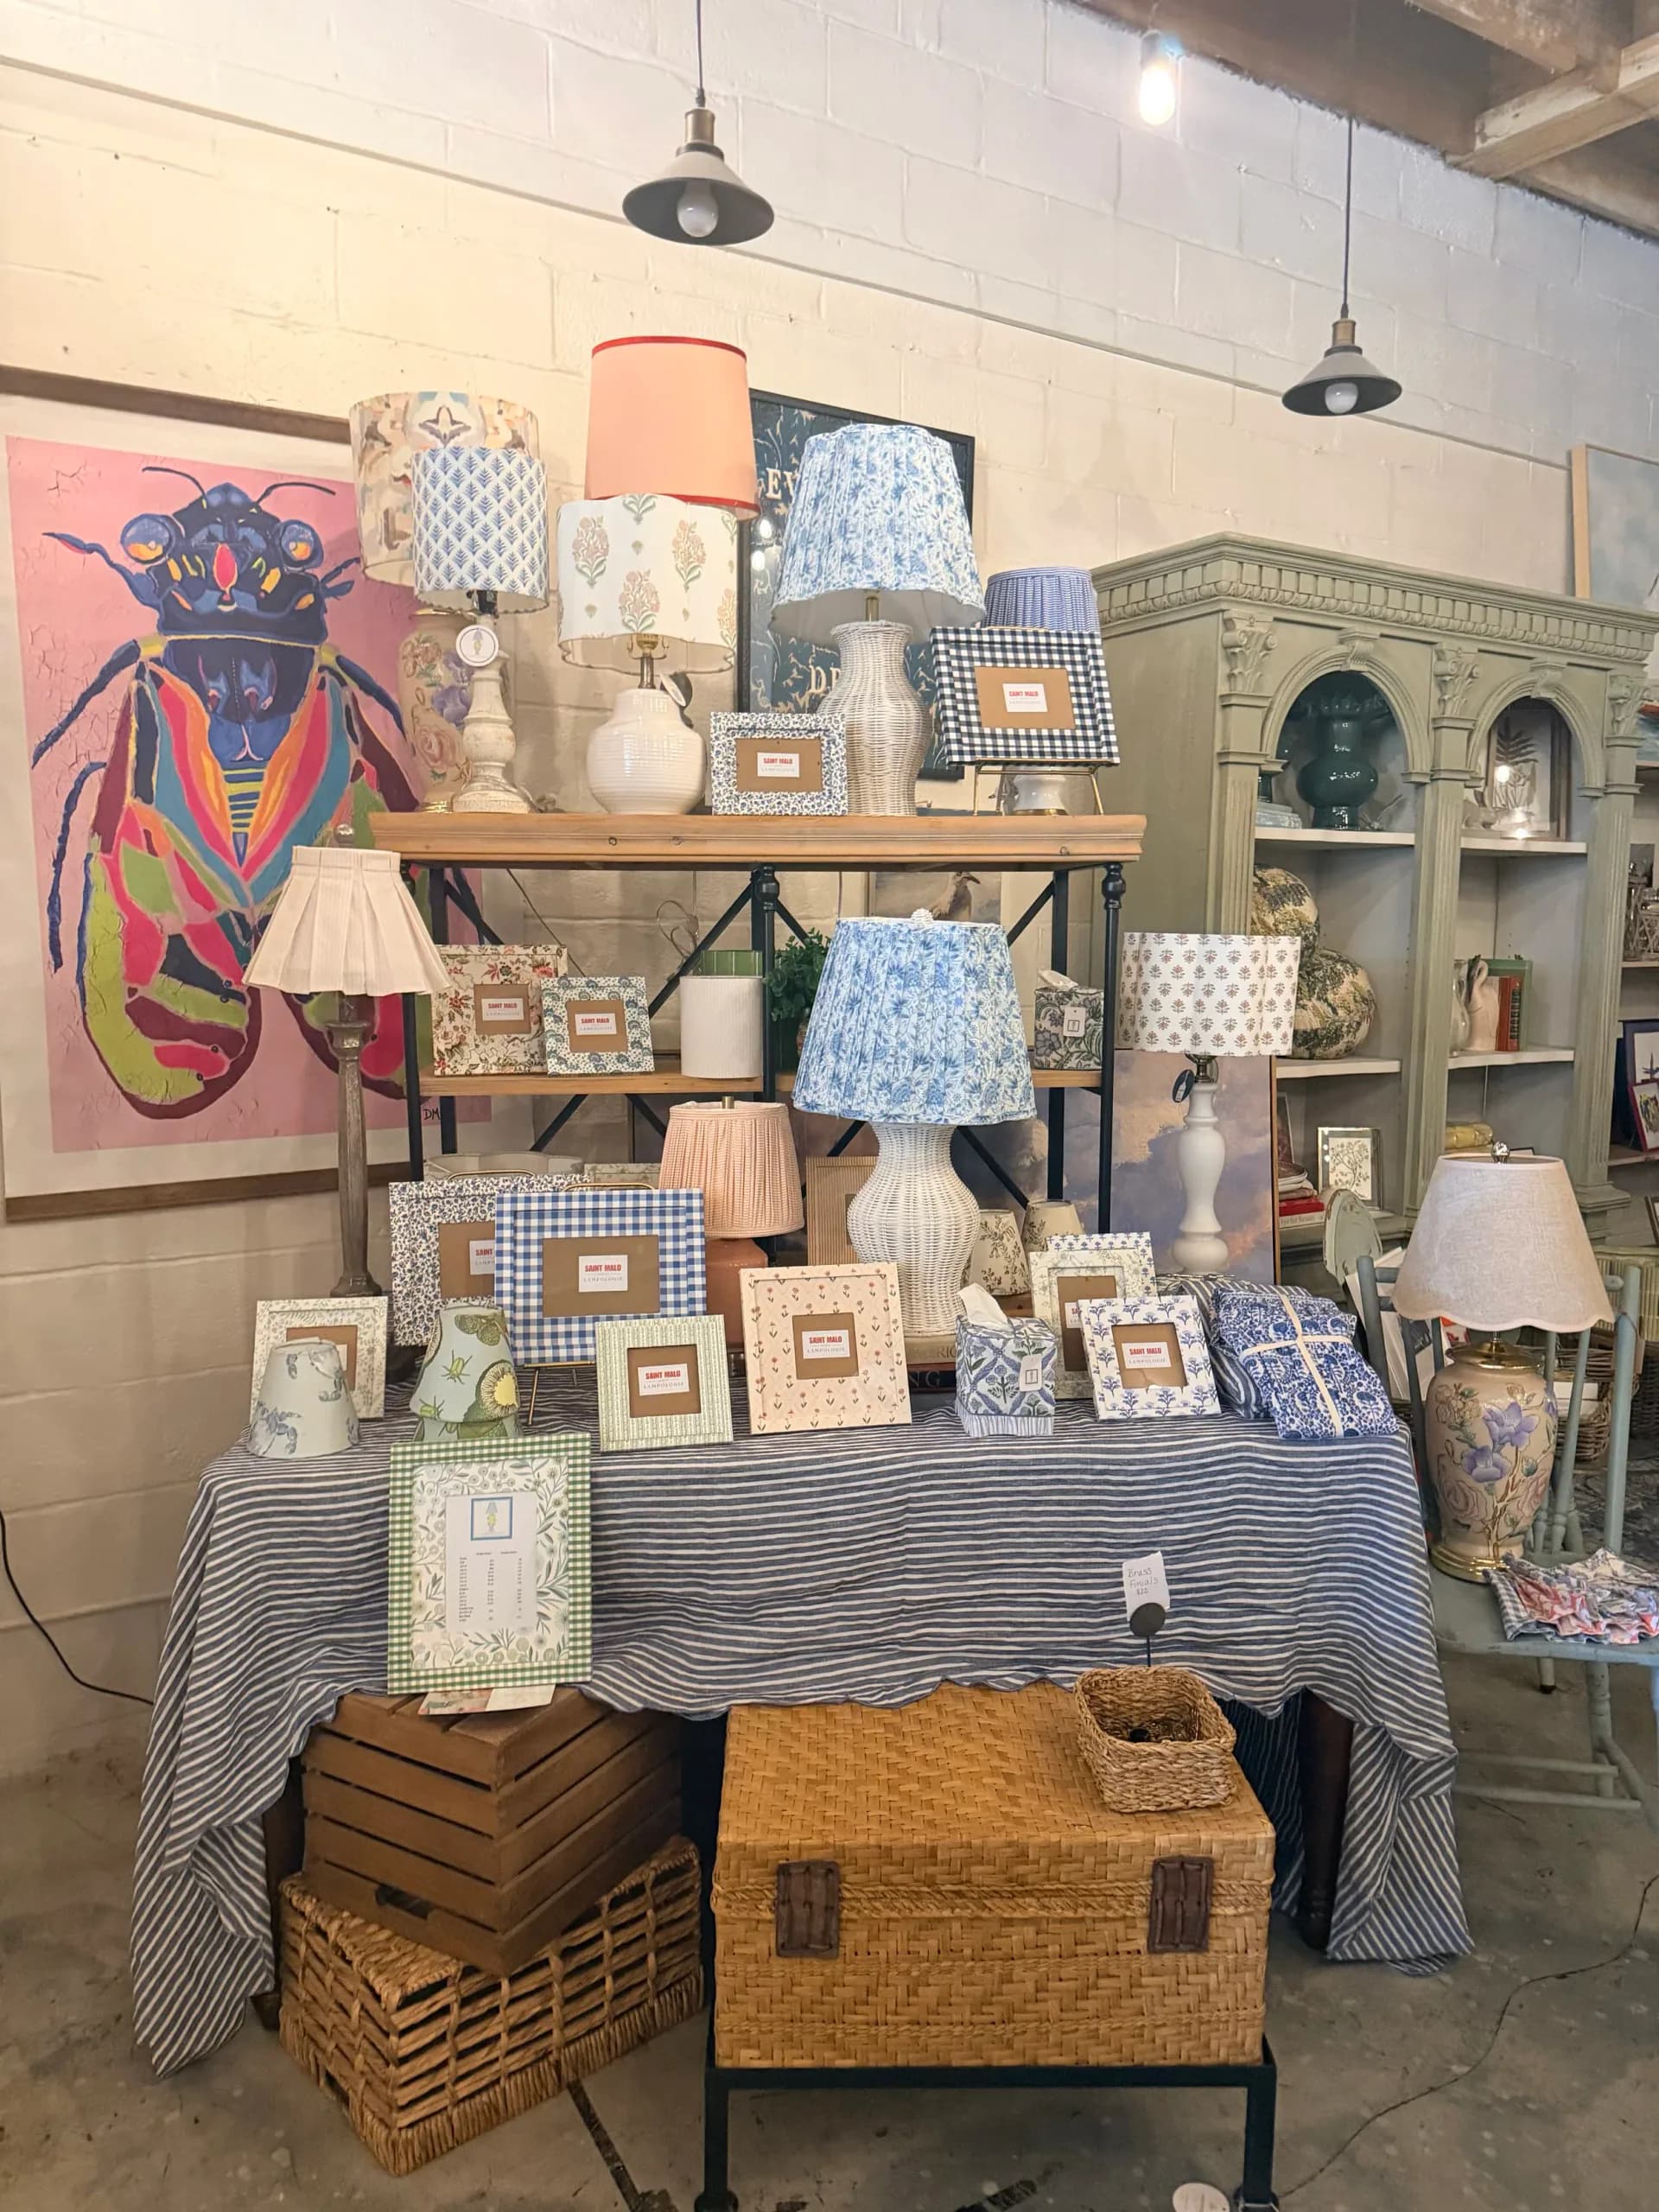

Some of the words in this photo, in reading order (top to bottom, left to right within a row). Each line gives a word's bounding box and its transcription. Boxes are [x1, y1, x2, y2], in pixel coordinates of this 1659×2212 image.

[584, 1264, 603, 1273] SAINT
[604, 1263, 622, 1272] MALO
[809, 1336, 825, 1344] SAINT
[826, 1335, 842, 1344] MALO
[645, 1371, 663, 1380] SAINT
[664, 1370, 681, 1378] MALO
[1128, 1567, 1152, 1578] Brass
